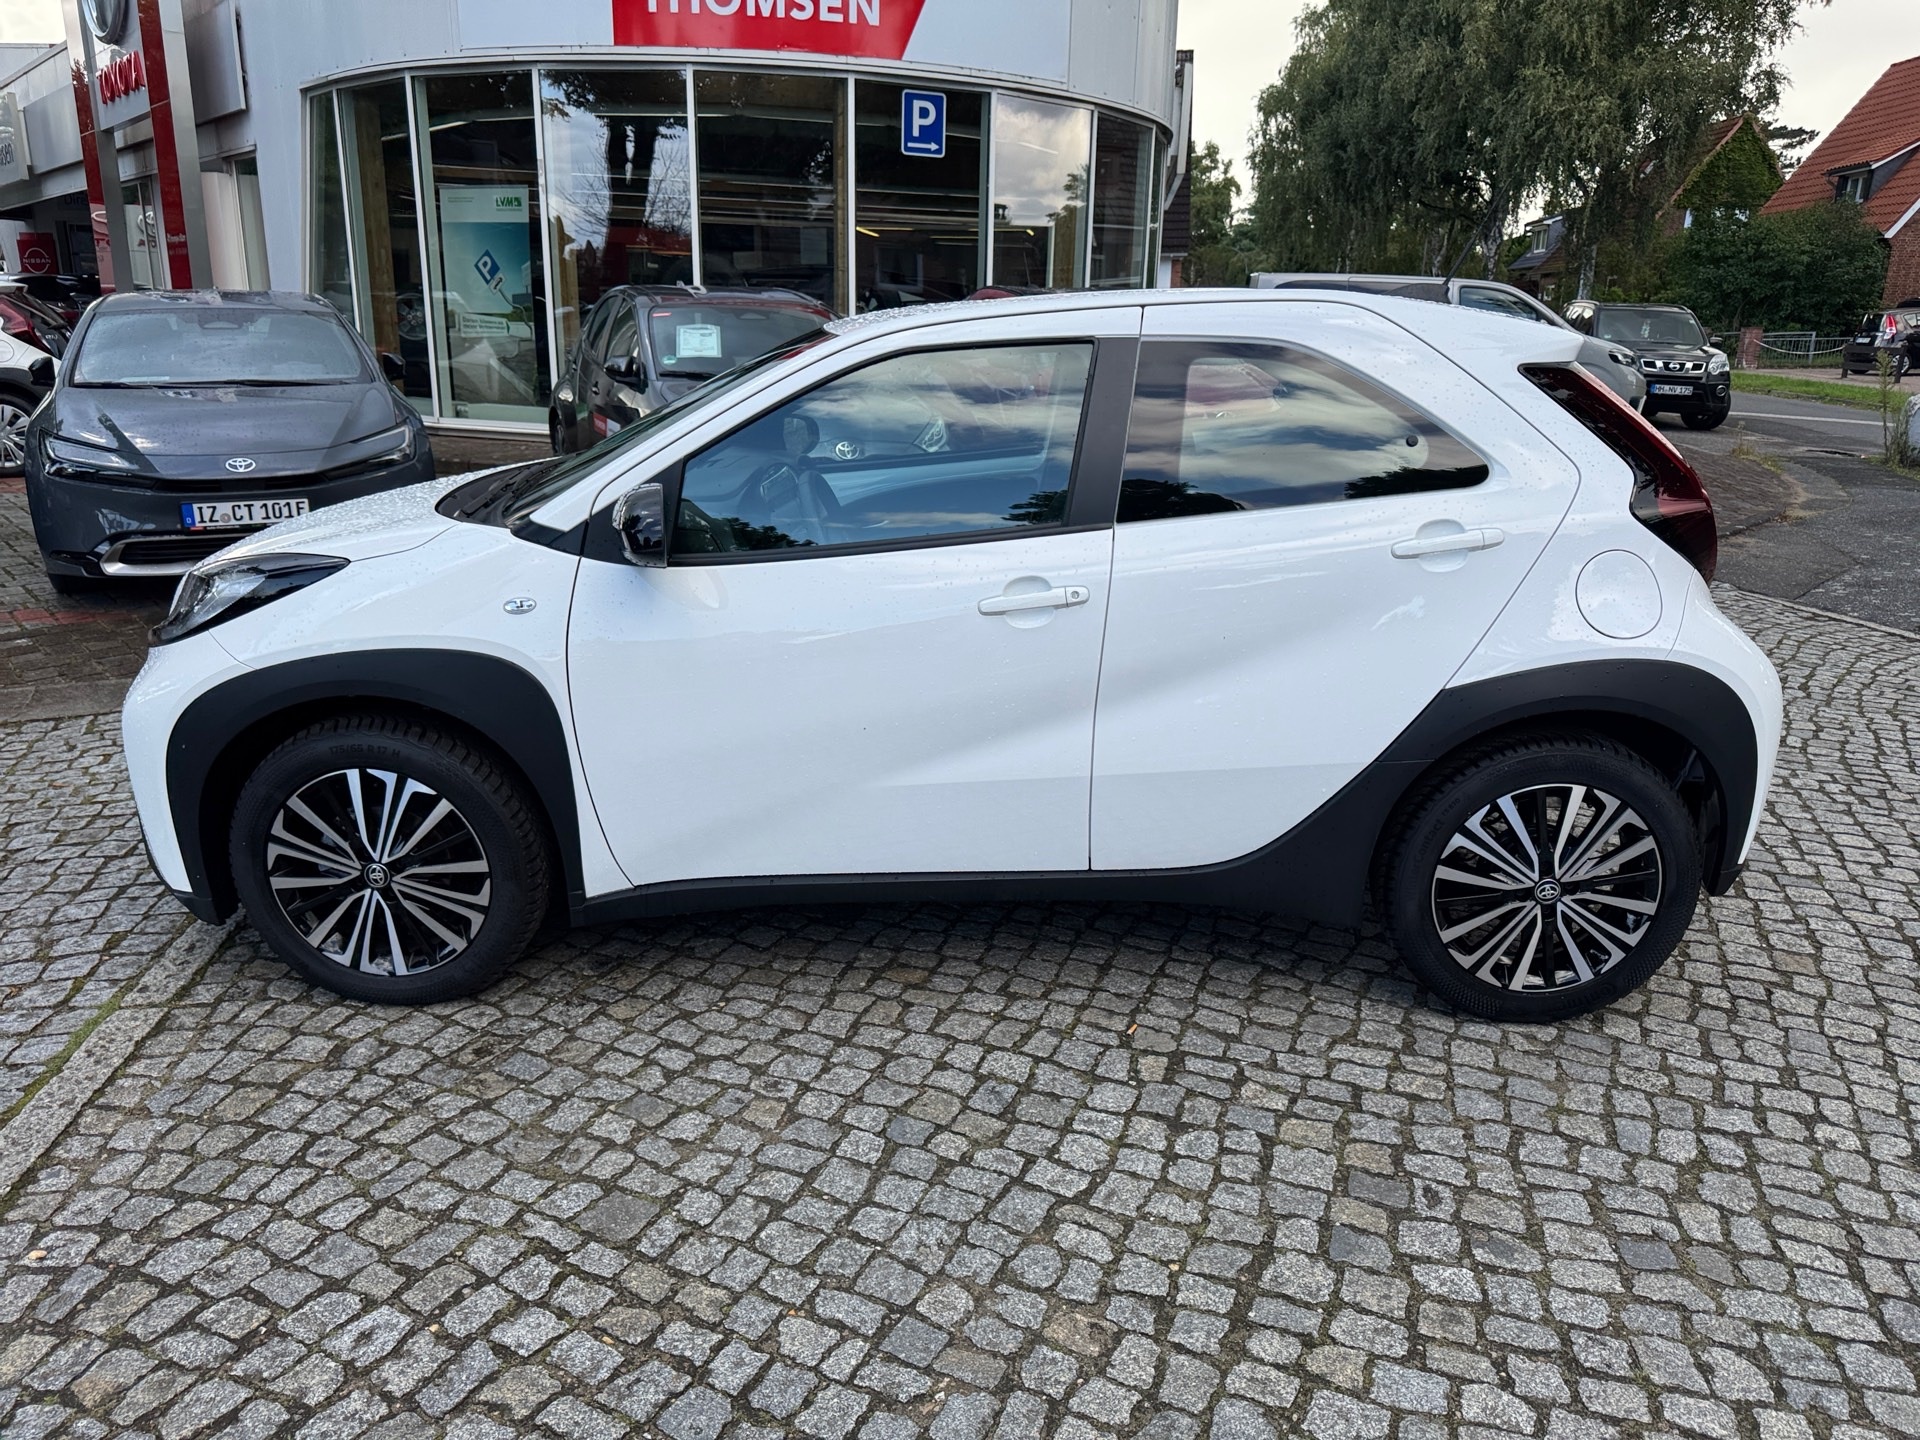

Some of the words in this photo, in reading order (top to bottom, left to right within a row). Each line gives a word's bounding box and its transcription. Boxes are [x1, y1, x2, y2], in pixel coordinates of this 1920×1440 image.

[96, 50, 146, 106] TOYOTA
[912, 99, 936, 137] P
[1679, 387, 1692, 395] 175
[197, 505, 219, 524] IZ
[231, 504, 254, 521] CT
